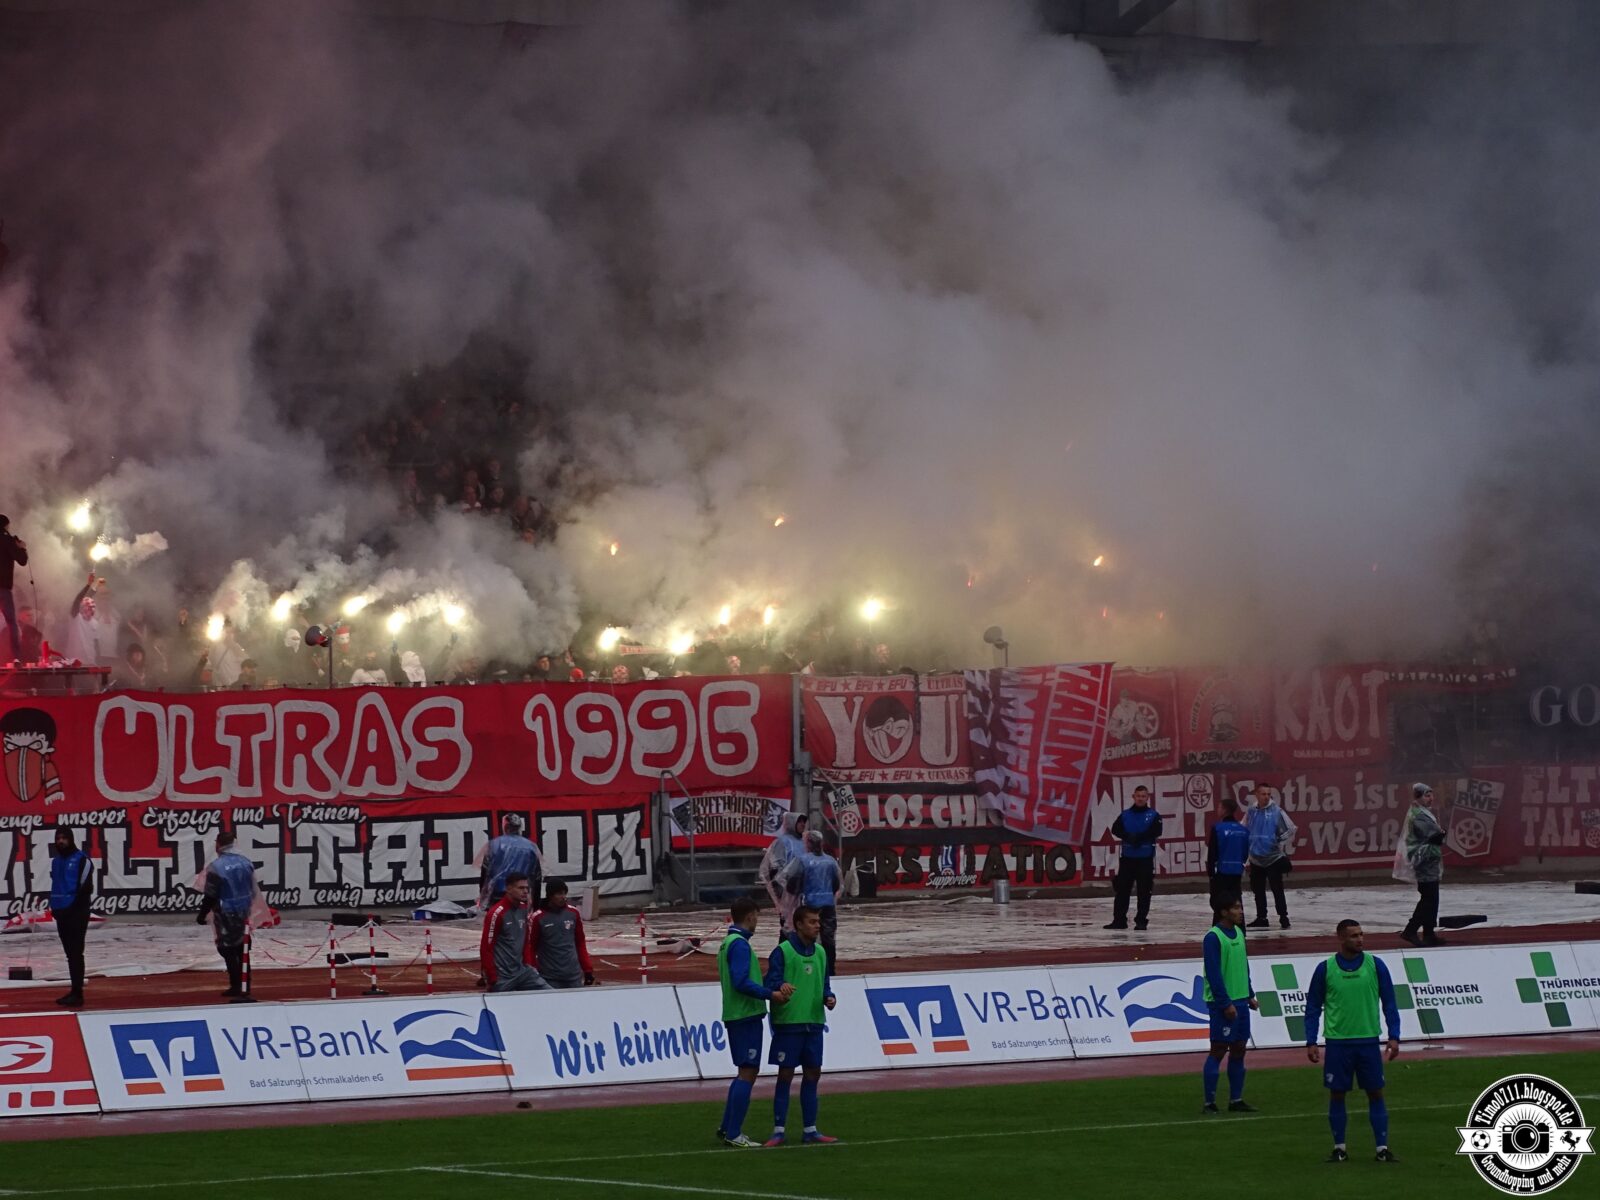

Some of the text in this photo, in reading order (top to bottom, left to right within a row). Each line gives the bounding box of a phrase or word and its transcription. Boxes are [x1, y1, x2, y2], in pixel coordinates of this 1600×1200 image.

[94, 680, 760, 802] ULTRAS 1996
[1521, 765, 1600, 804] ELT
[867, 794, 923, 829] LOS
[90, 893, 128, 914] age
[964, 985, 1115, 1024] VR-Bank
[1412, 983, 1479, 995] THÜRINGEN
[1416, 995, 1483, 1007] RECYCLING
[222, 1019, 390, 1062] VR-Bank
[546, 1029, 605, 1079] Wir
[991, 1040, 1007, 1049] Bad
[1008, 1038, 1047, 1050] Salzungen
[1048, 1036, 1098, 1047] Schmalkalden
[249, 1073, 384, 1088] Bad Salzungen Schmalkalden eG
